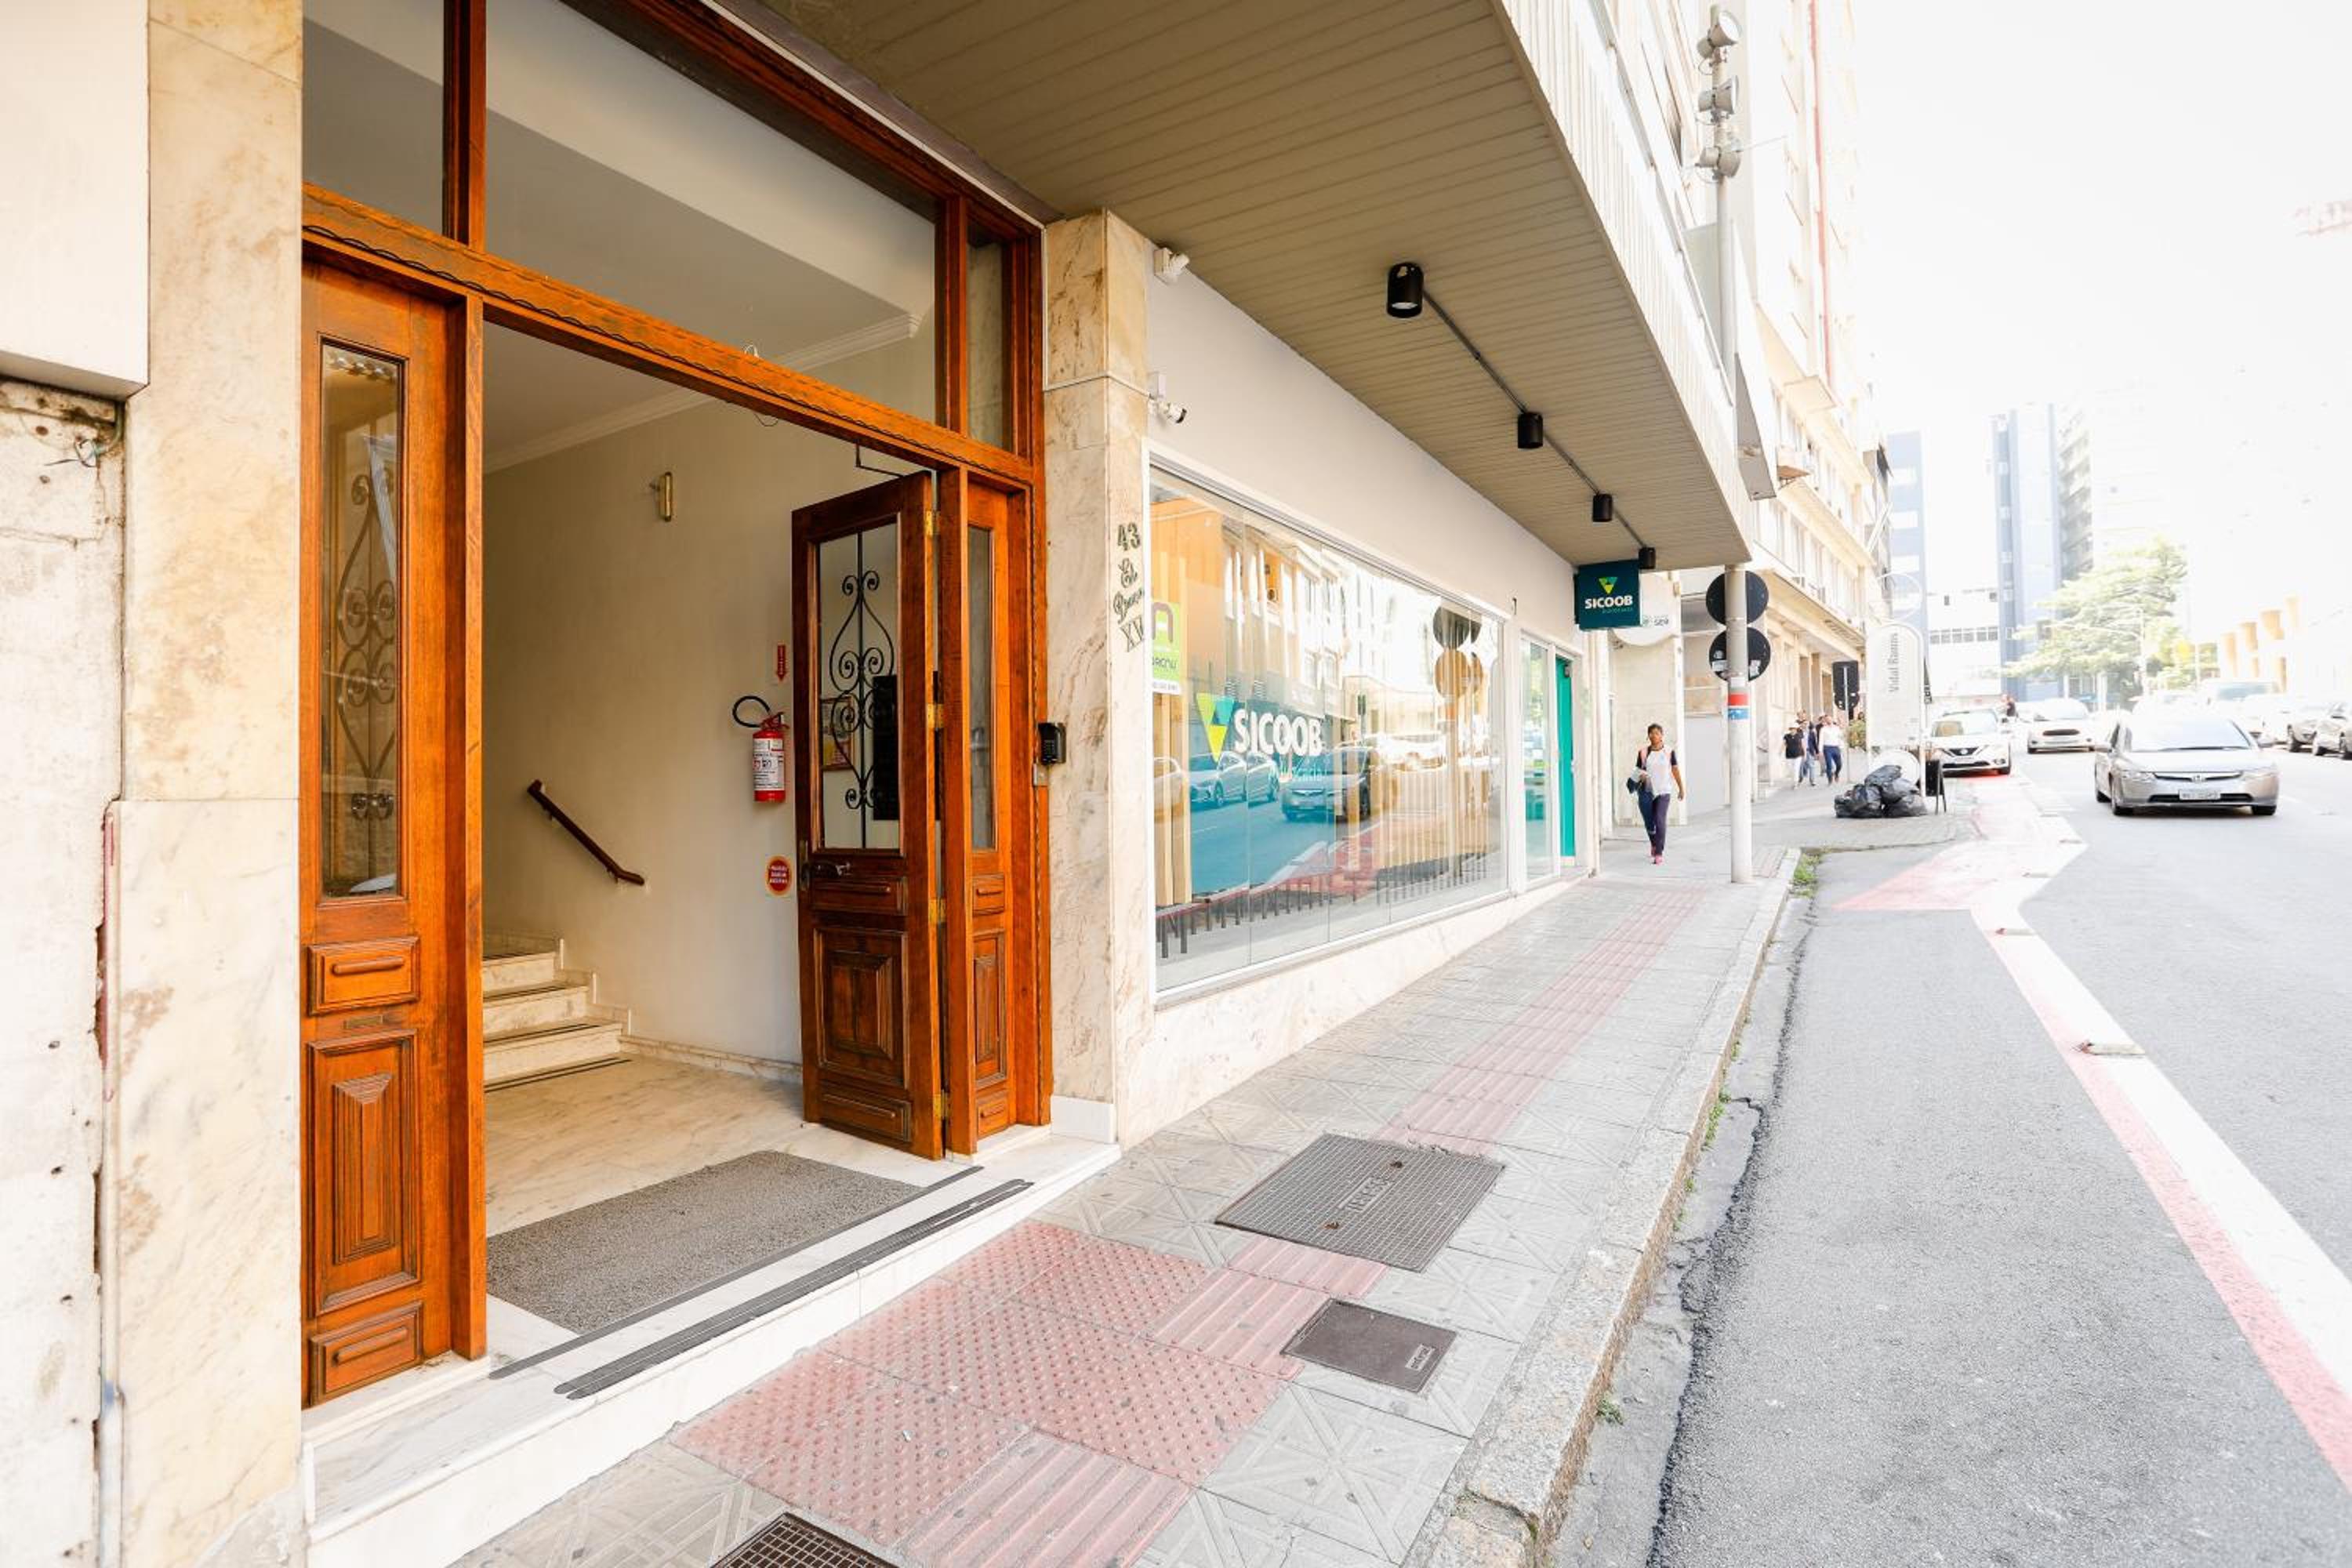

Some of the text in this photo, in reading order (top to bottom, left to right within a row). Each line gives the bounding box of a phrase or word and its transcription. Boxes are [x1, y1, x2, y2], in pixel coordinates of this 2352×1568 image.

[1117, 522, 1141, 550] 43
[1584, 595, 1633, 609] SICOOB
[1233, 708, 1323, 757] SICOOB
